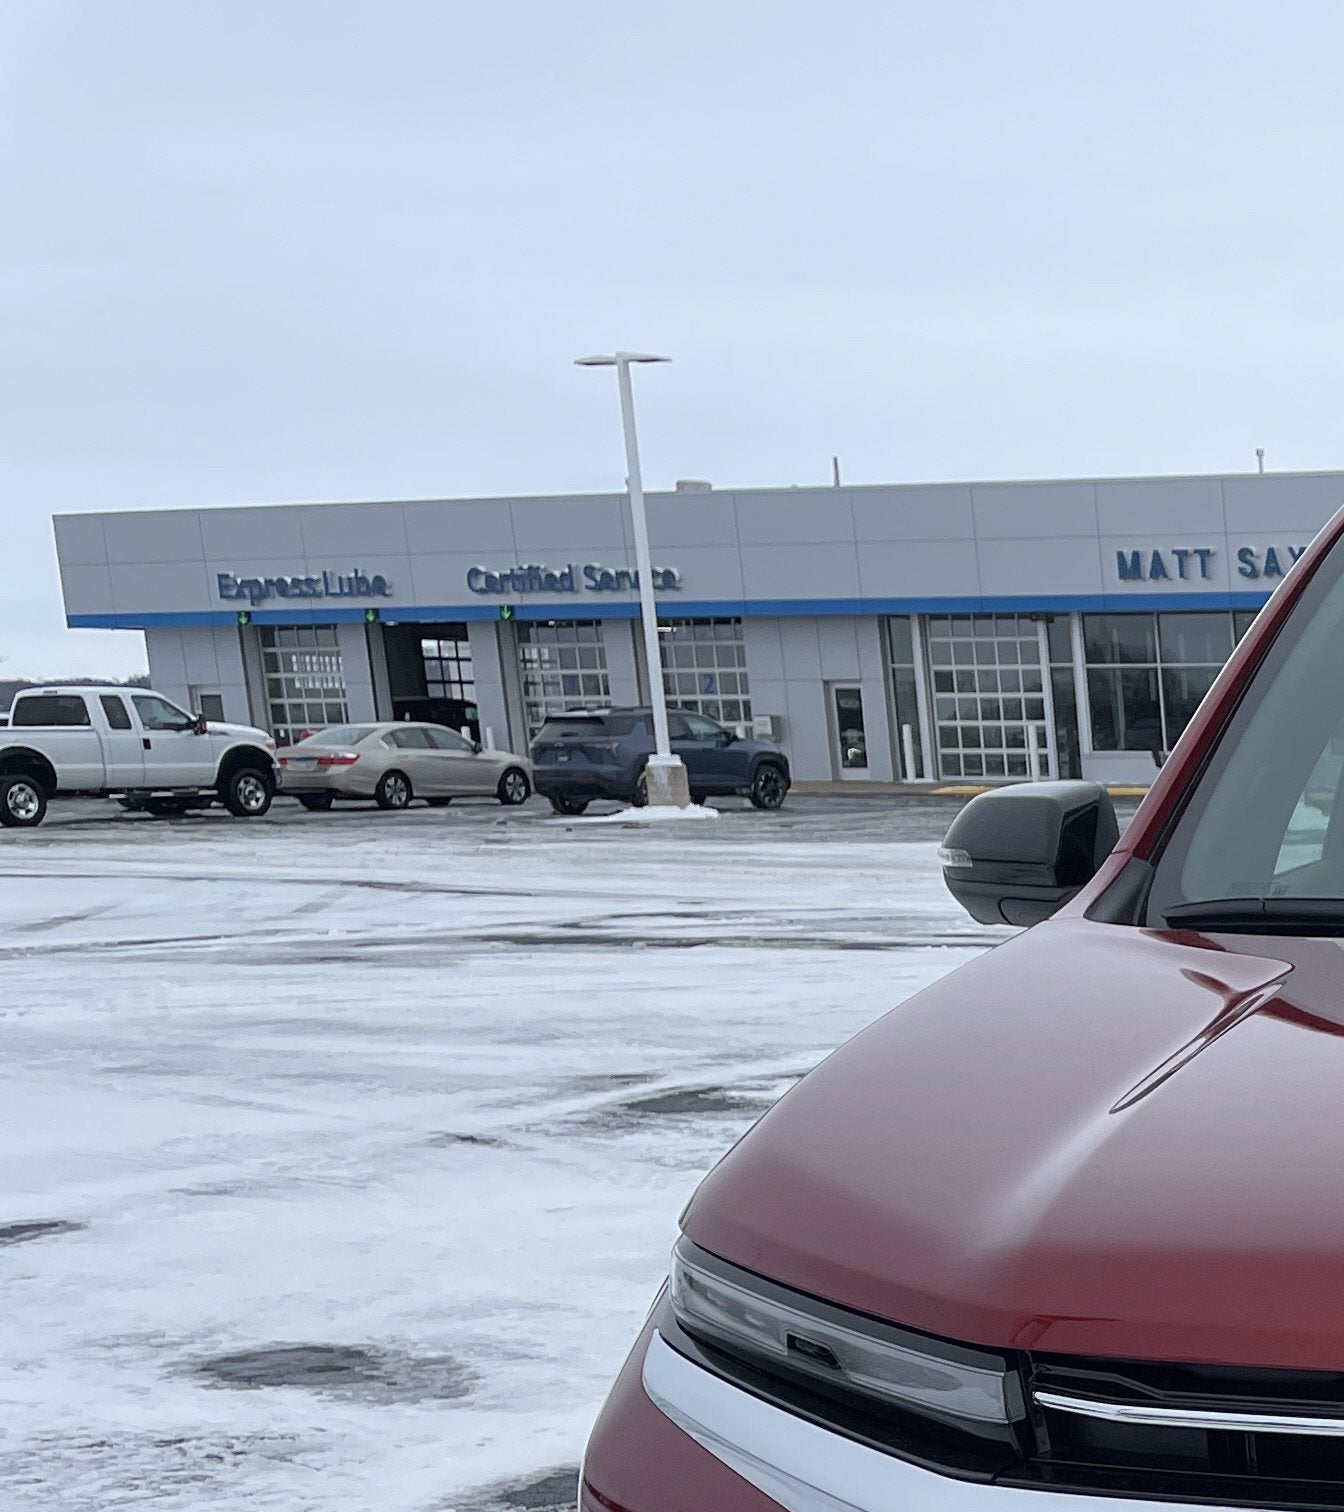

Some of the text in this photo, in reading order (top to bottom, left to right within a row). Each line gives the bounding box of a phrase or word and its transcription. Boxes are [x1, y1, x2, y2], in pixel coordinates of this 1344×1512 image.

[467, 563, 682, 593] Certified Servce
[1116, 548, 1211, 581] MATT
[217, 567, 392, 606] Express Lube
[703, 673, 715, 694] 2
